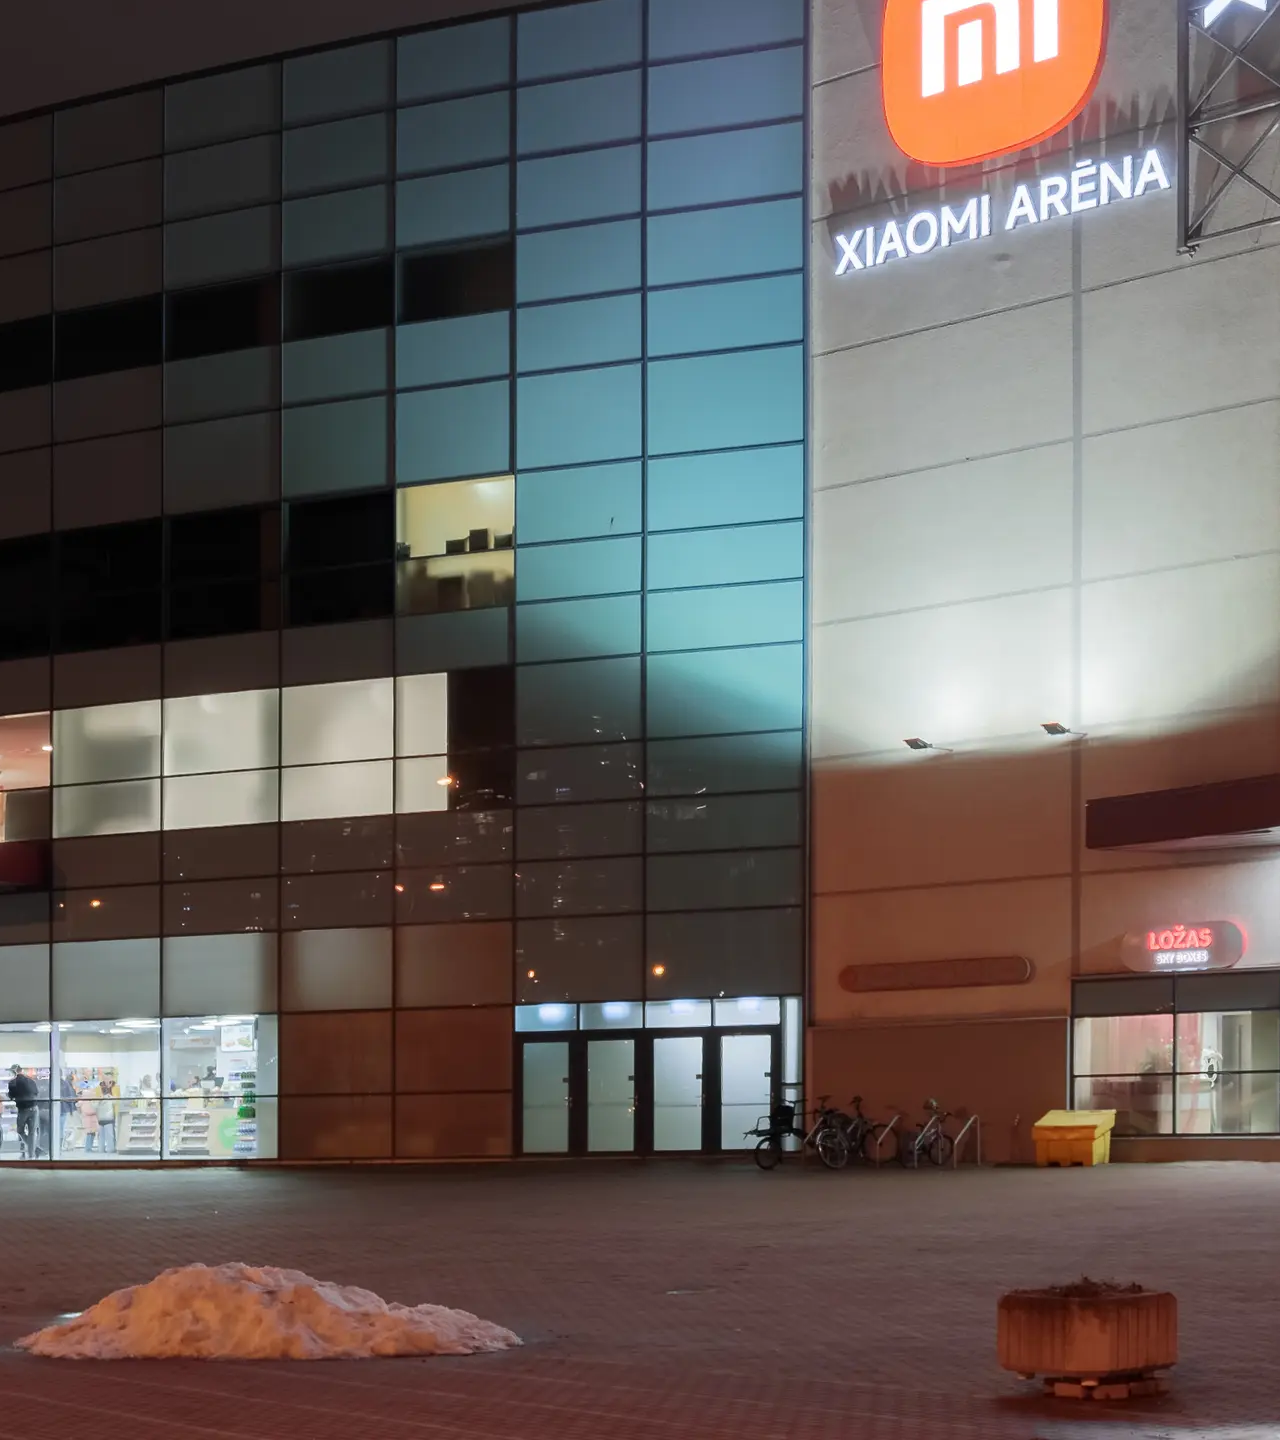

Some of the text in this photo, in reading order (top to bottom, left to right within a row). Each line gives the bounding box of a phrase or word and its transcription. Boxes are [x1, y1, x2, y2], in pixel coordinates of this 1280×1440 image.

[834, 148, 1171, 276] XIAOMI ARĒNA
[1147, 923, 1213, 951] LOŽAS
